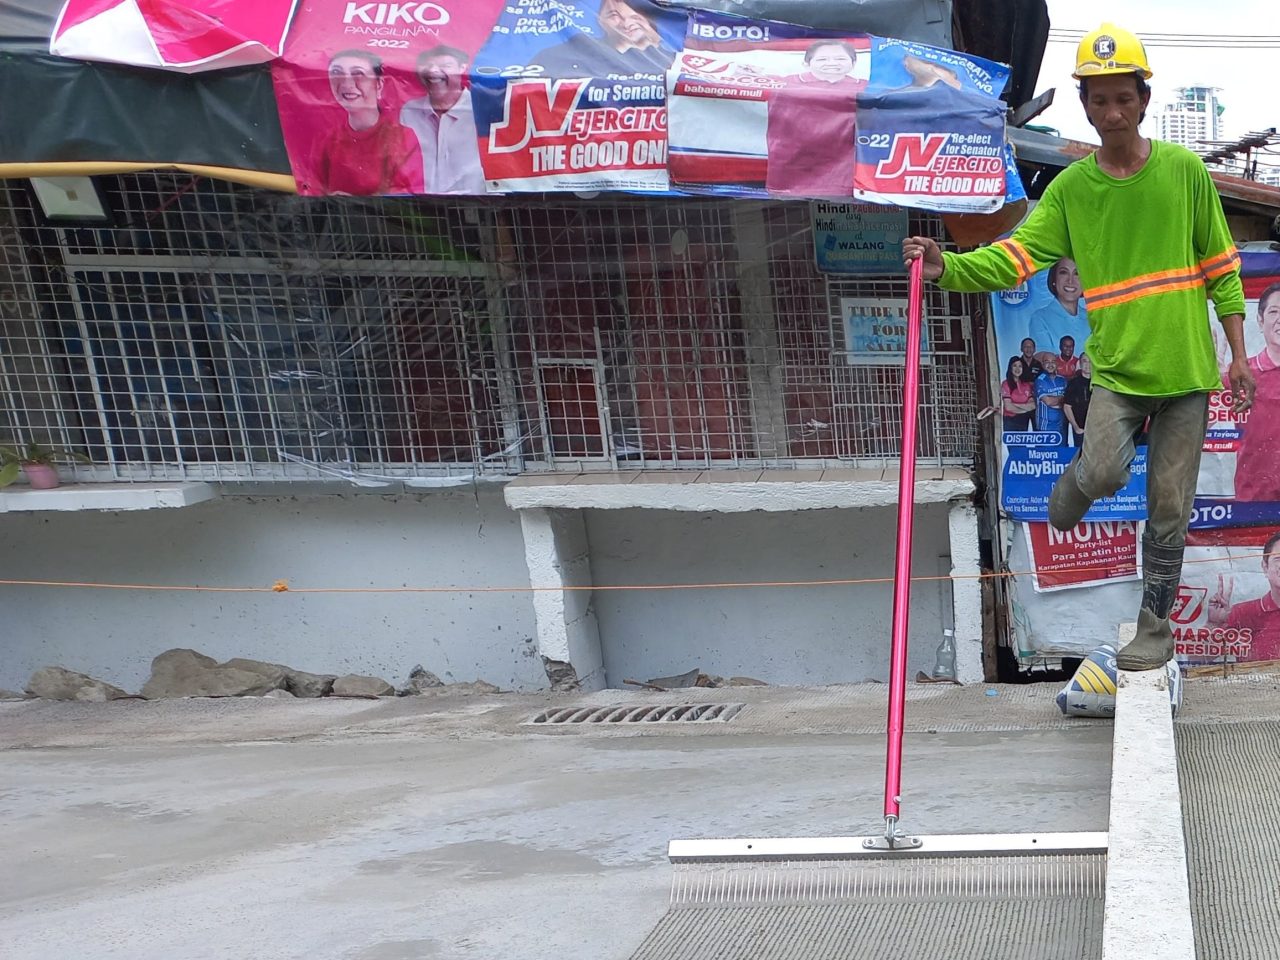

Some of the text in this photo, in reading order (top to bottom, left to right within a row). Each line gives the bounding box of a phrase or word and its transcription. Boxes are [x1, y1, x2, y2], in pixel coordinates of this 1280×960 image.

[342, 2, 451, 26] KIKO
[343, 26, 440, 37] PANGILINAN
[692, 23, 770, 42] IBOTO!
[366, 39, 410, 49] 2022
[500, 65, 545, 78] 22
[588, 84, 666, 102] for Senato
[684, 84, 764, 99] babangon muli
[869, 134, 890, 148] 22
[951, 133, 992, 145] Re-elect
[529, 146, 567, 173] THE
[569, 140, 629, 169] GOOD
[945, 145, 1001, 157] for Senator!
[931, 155, 1003, 176] EJERCITO
[904, 176, 1003, 194] THE GOOD ONE
[816, 203, 850, 214] Hindi
[815, 219, 836, 232] Hindi
[838, 241, 885, 250] WALANG
[1000, 291, 1030, 300] UNITED
[848, 306, 892, 317] TUBE
[872, 321, 907, 336] FOR
[1005, 434, 1056, 443] DISTRICT 2
[1028, 449, 1059, 461] Mayora
[1008, 460, 1069, 478] AbbyBin
[1188, 504, 1232, 522] OTO!
[1073, 538, 1113, 550] Party-list
[1052, 552, 1076, 562] Para
[1078, 551, 1089, 559] sa
[1091, 549, 1112, 557] atin
[1038, 560, 1076, 571] Karapatan
[1174, 643, 1251, 657] RESIDENT
